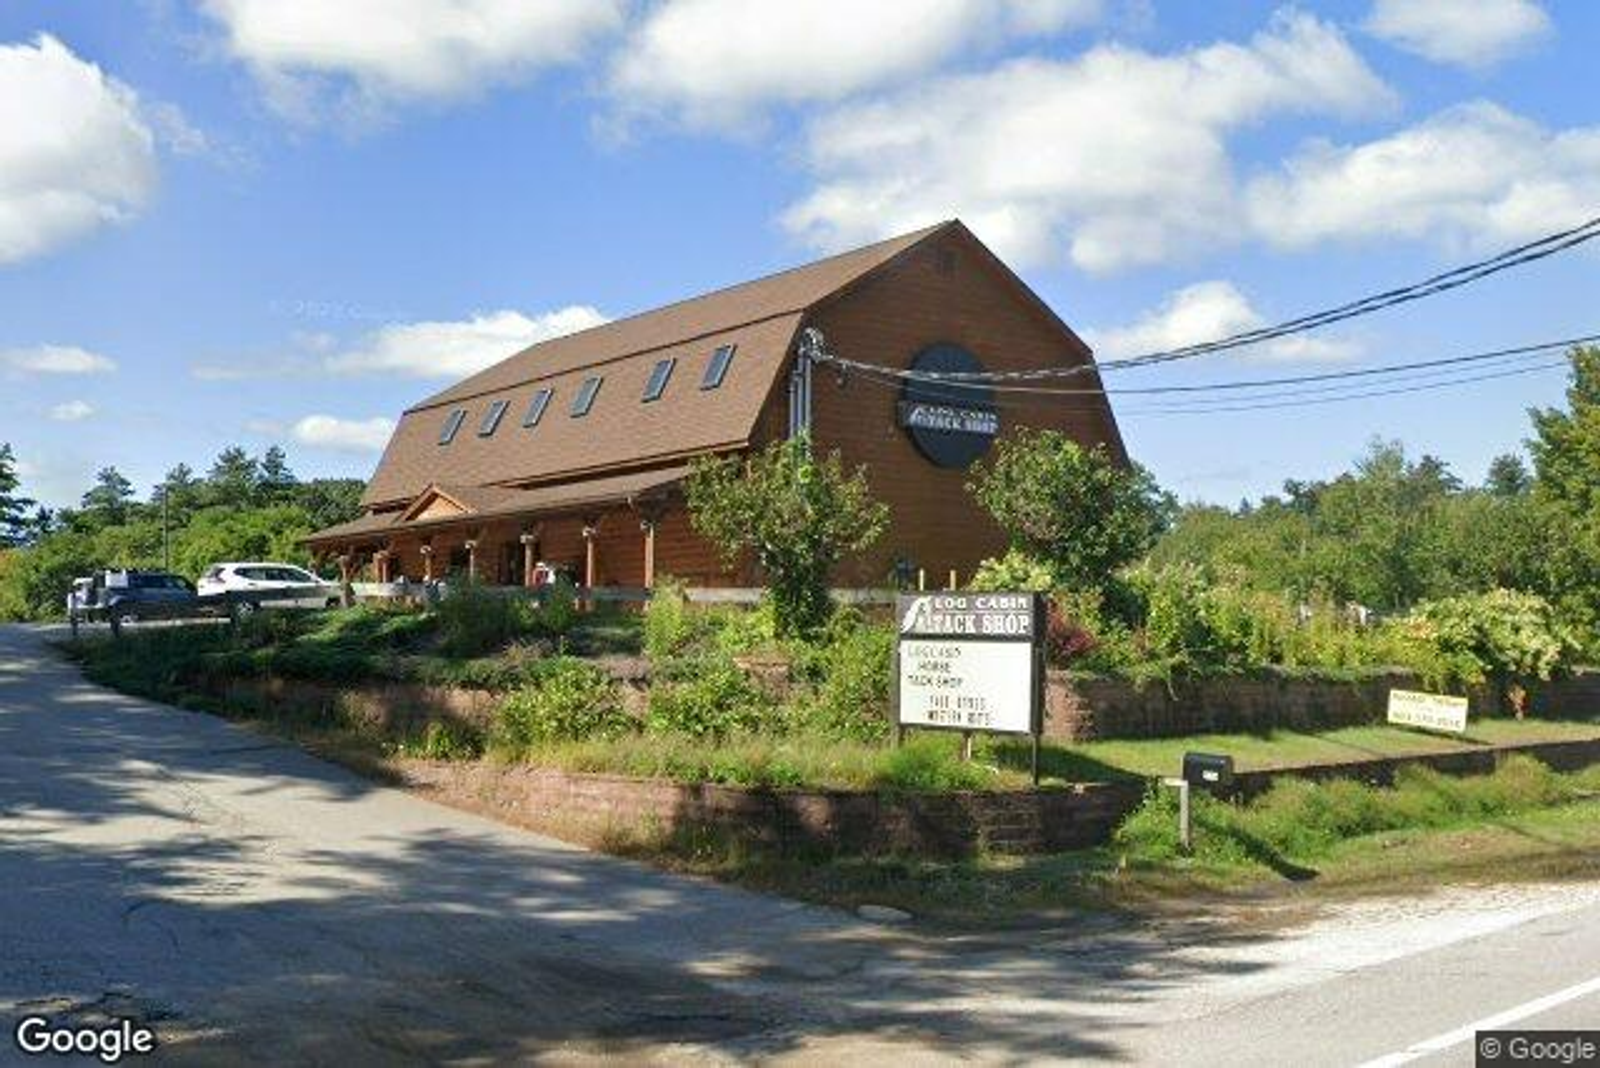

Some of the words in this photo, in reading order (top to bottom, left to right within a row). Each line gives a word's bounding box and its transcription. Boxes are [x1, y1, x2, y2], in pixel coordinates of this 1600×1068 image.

[927, 415, 961, 429] TACK
[935, 597, 967, 609] LOG
[975, 597, 1027, 609] CABIN
[932, 615, 976, 634] TACK
[982, 614, 1029, 634] SHOP
